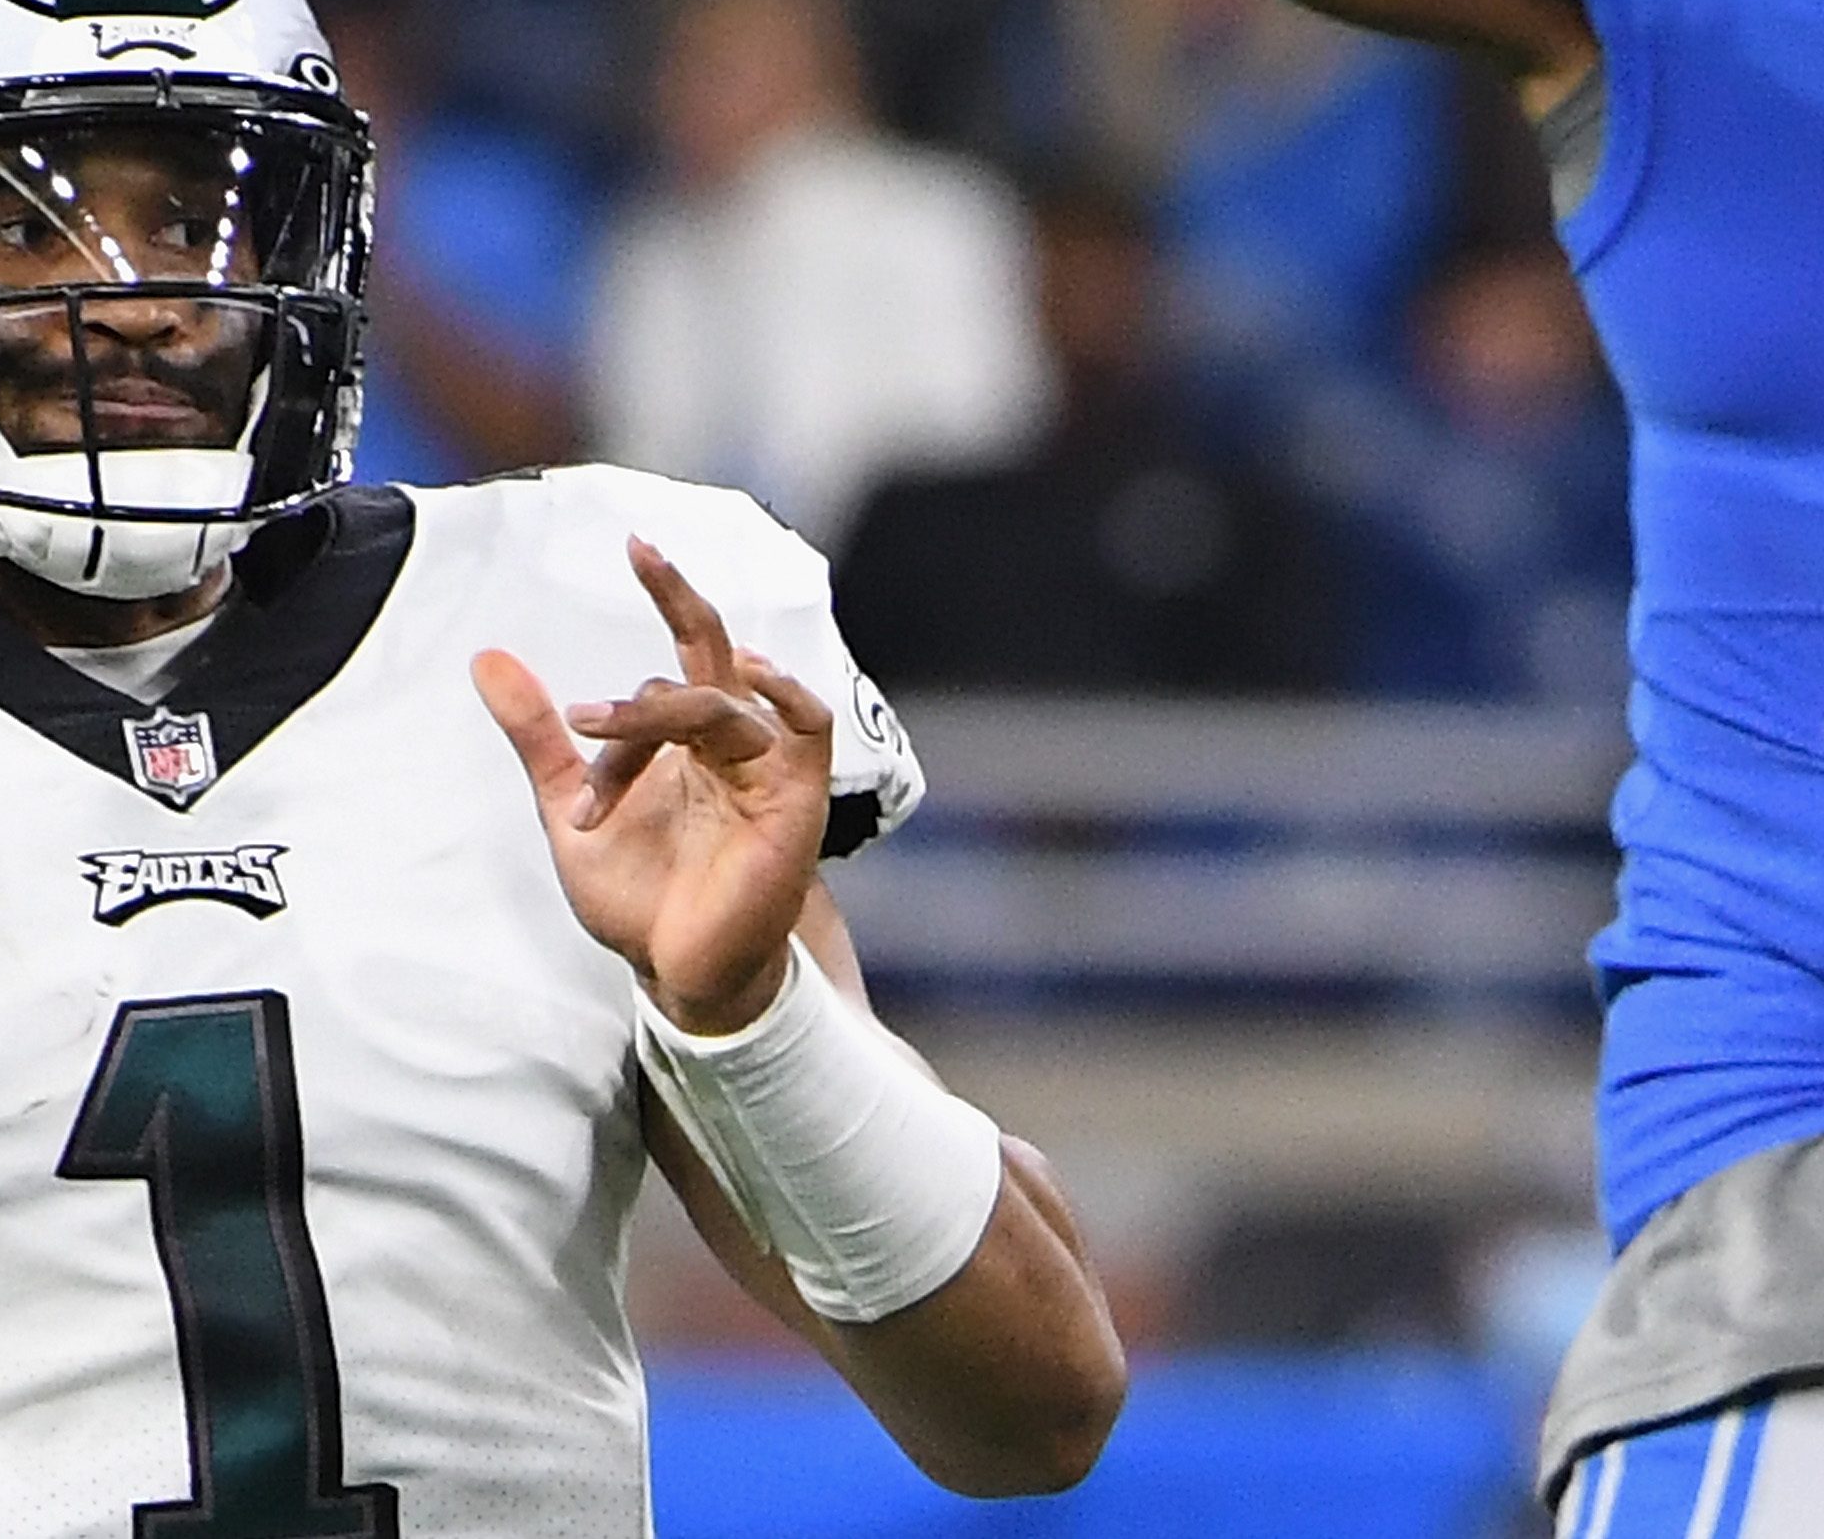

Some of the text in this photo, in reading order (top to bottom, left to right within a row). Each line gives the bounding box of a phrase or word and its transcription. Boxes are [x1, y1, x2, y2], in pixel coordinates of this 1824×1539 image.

[148, 745, 204, 783] NFL
[77, 844, 290, 928] EAGLES
[54, 987, 400, 1539] 1
